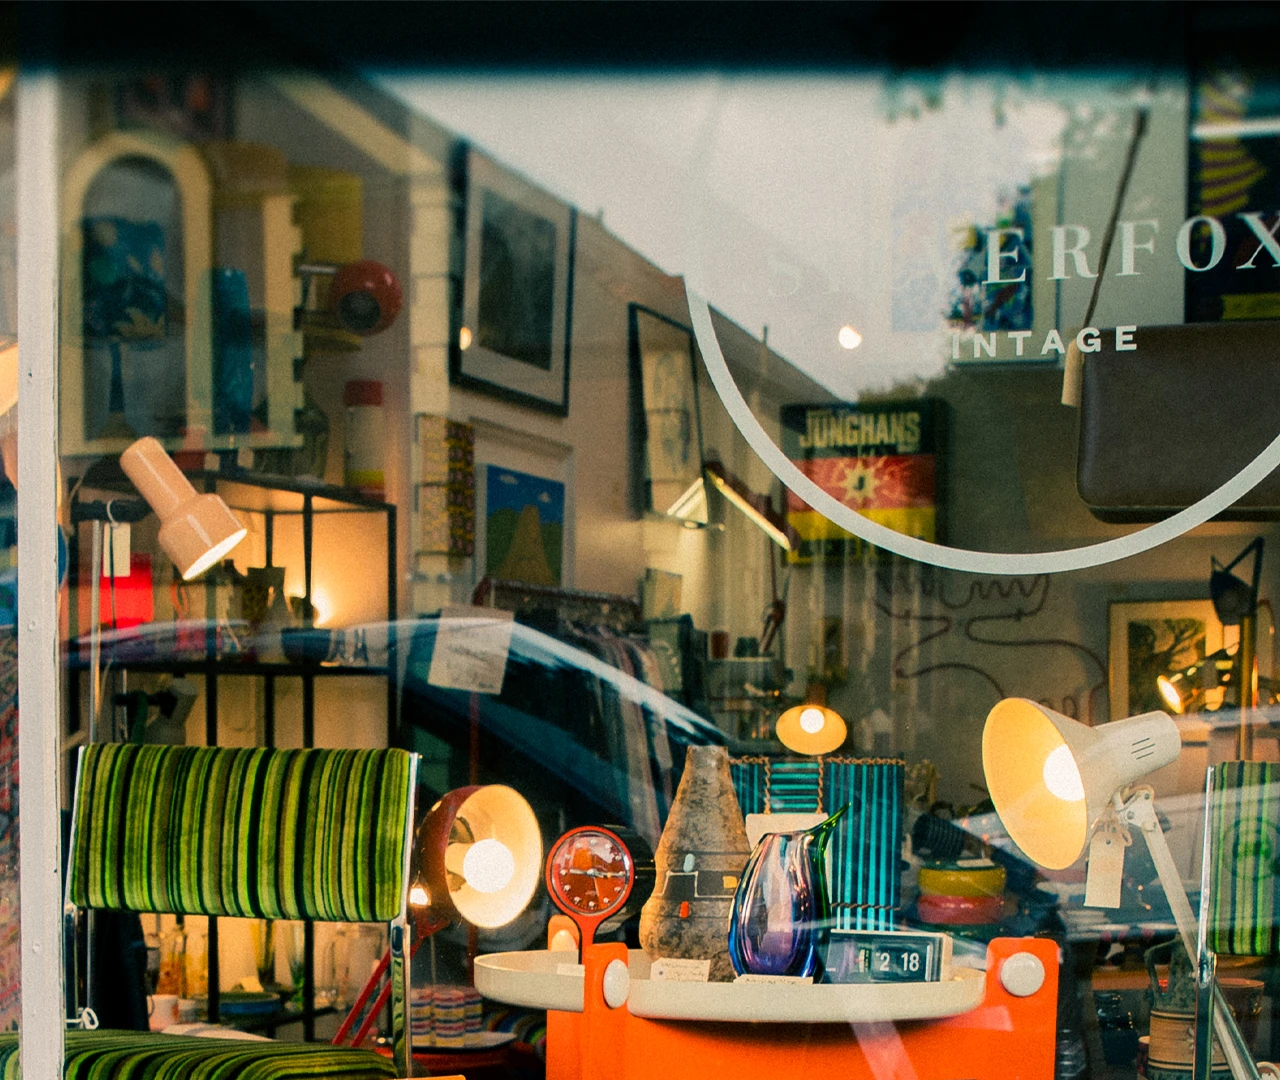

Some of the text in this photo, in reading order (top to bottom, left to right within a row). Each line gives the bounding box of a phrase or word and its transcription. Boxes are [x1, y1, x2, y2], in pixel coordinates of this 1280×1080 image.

[951, 325, 1138, 359] INTAGE
[799, 411, 921, 449] JUNGHANS
[900, 952, 920, 972] 18
